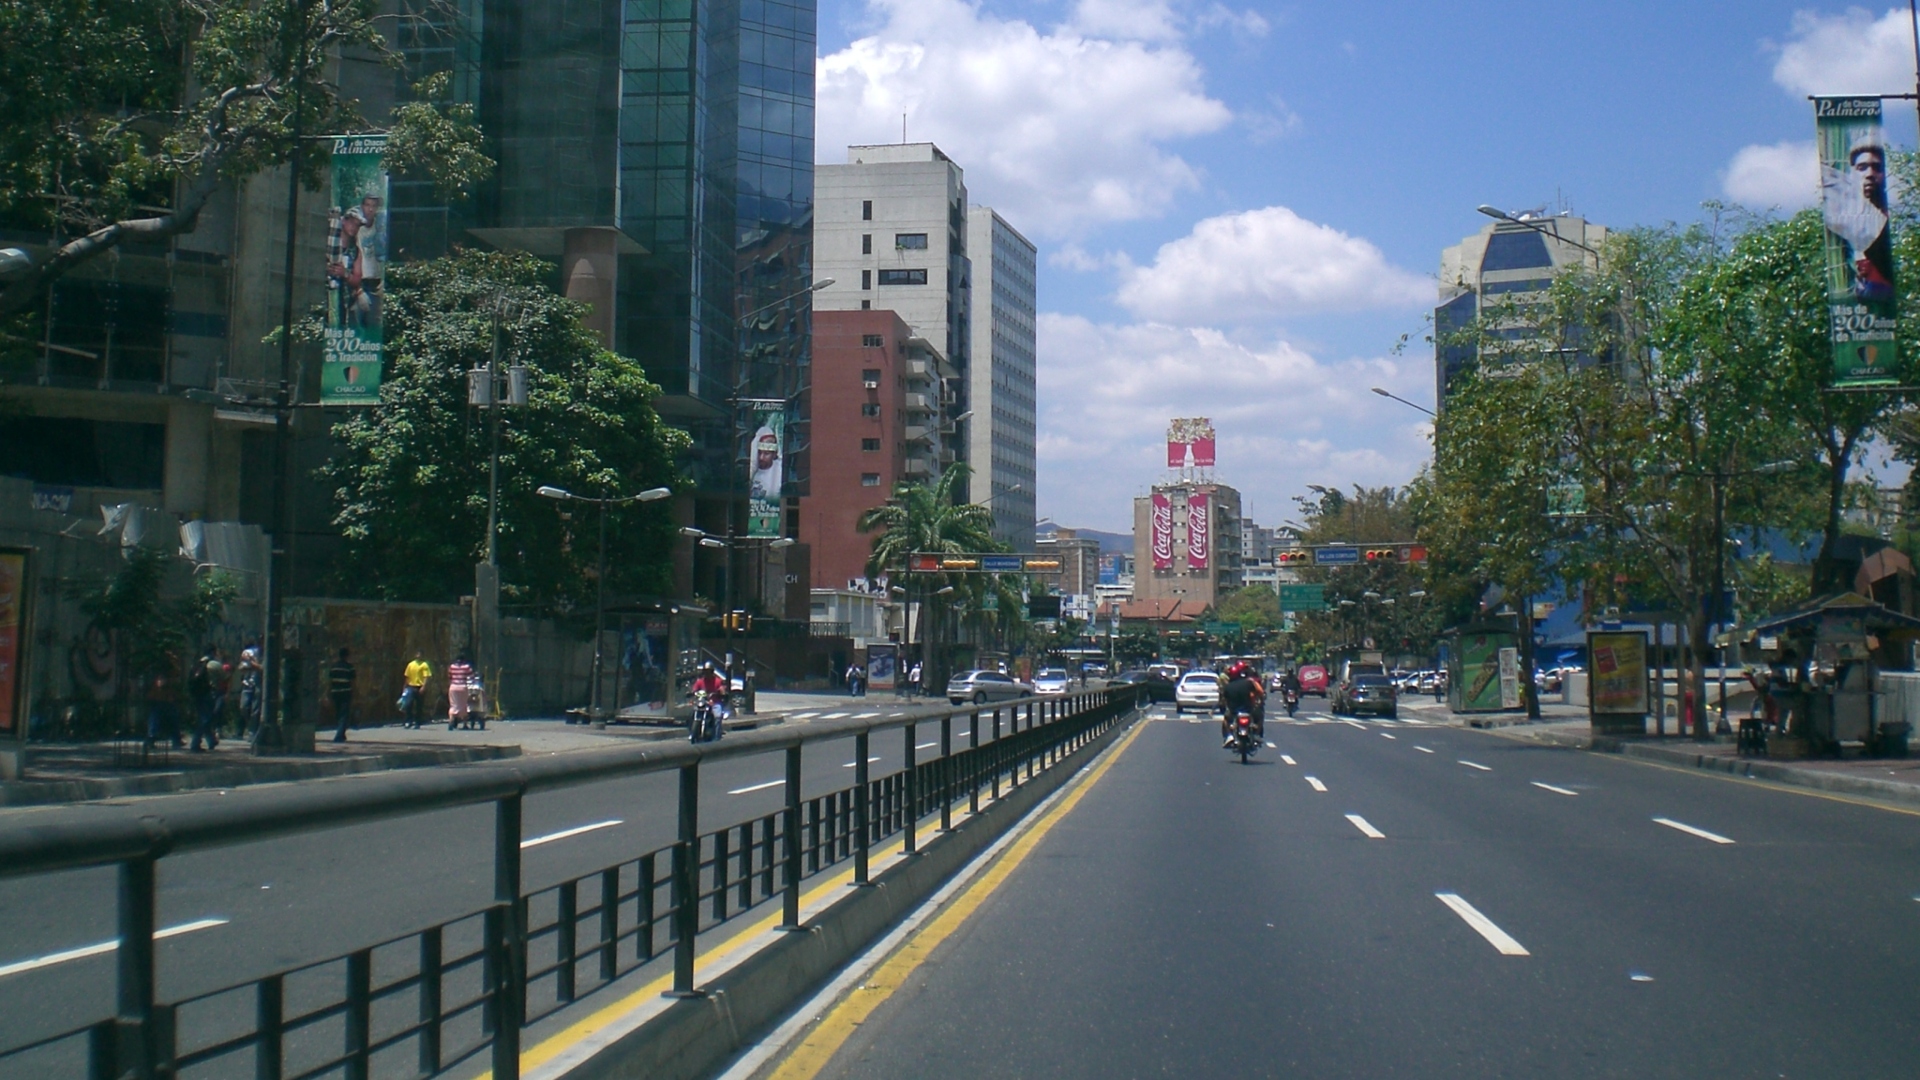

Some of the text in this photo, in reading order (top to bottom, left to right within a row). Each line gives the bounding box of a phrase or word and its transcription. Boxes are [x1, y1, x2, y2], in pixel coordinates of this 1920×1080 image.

[1817, 100, 1881, 116] Palmeros
[332, 138, 385, 154] Palmero
[1854, 303, 1868, 314] de
[1834, 314, 1876, 331] 200
[324, 327, 355, 338] Más de
[1835, 329, 1895, 342] de Tradición
[323, 337, 380, 352] 200 años
[325, 352, 378, 362] de Tradición
